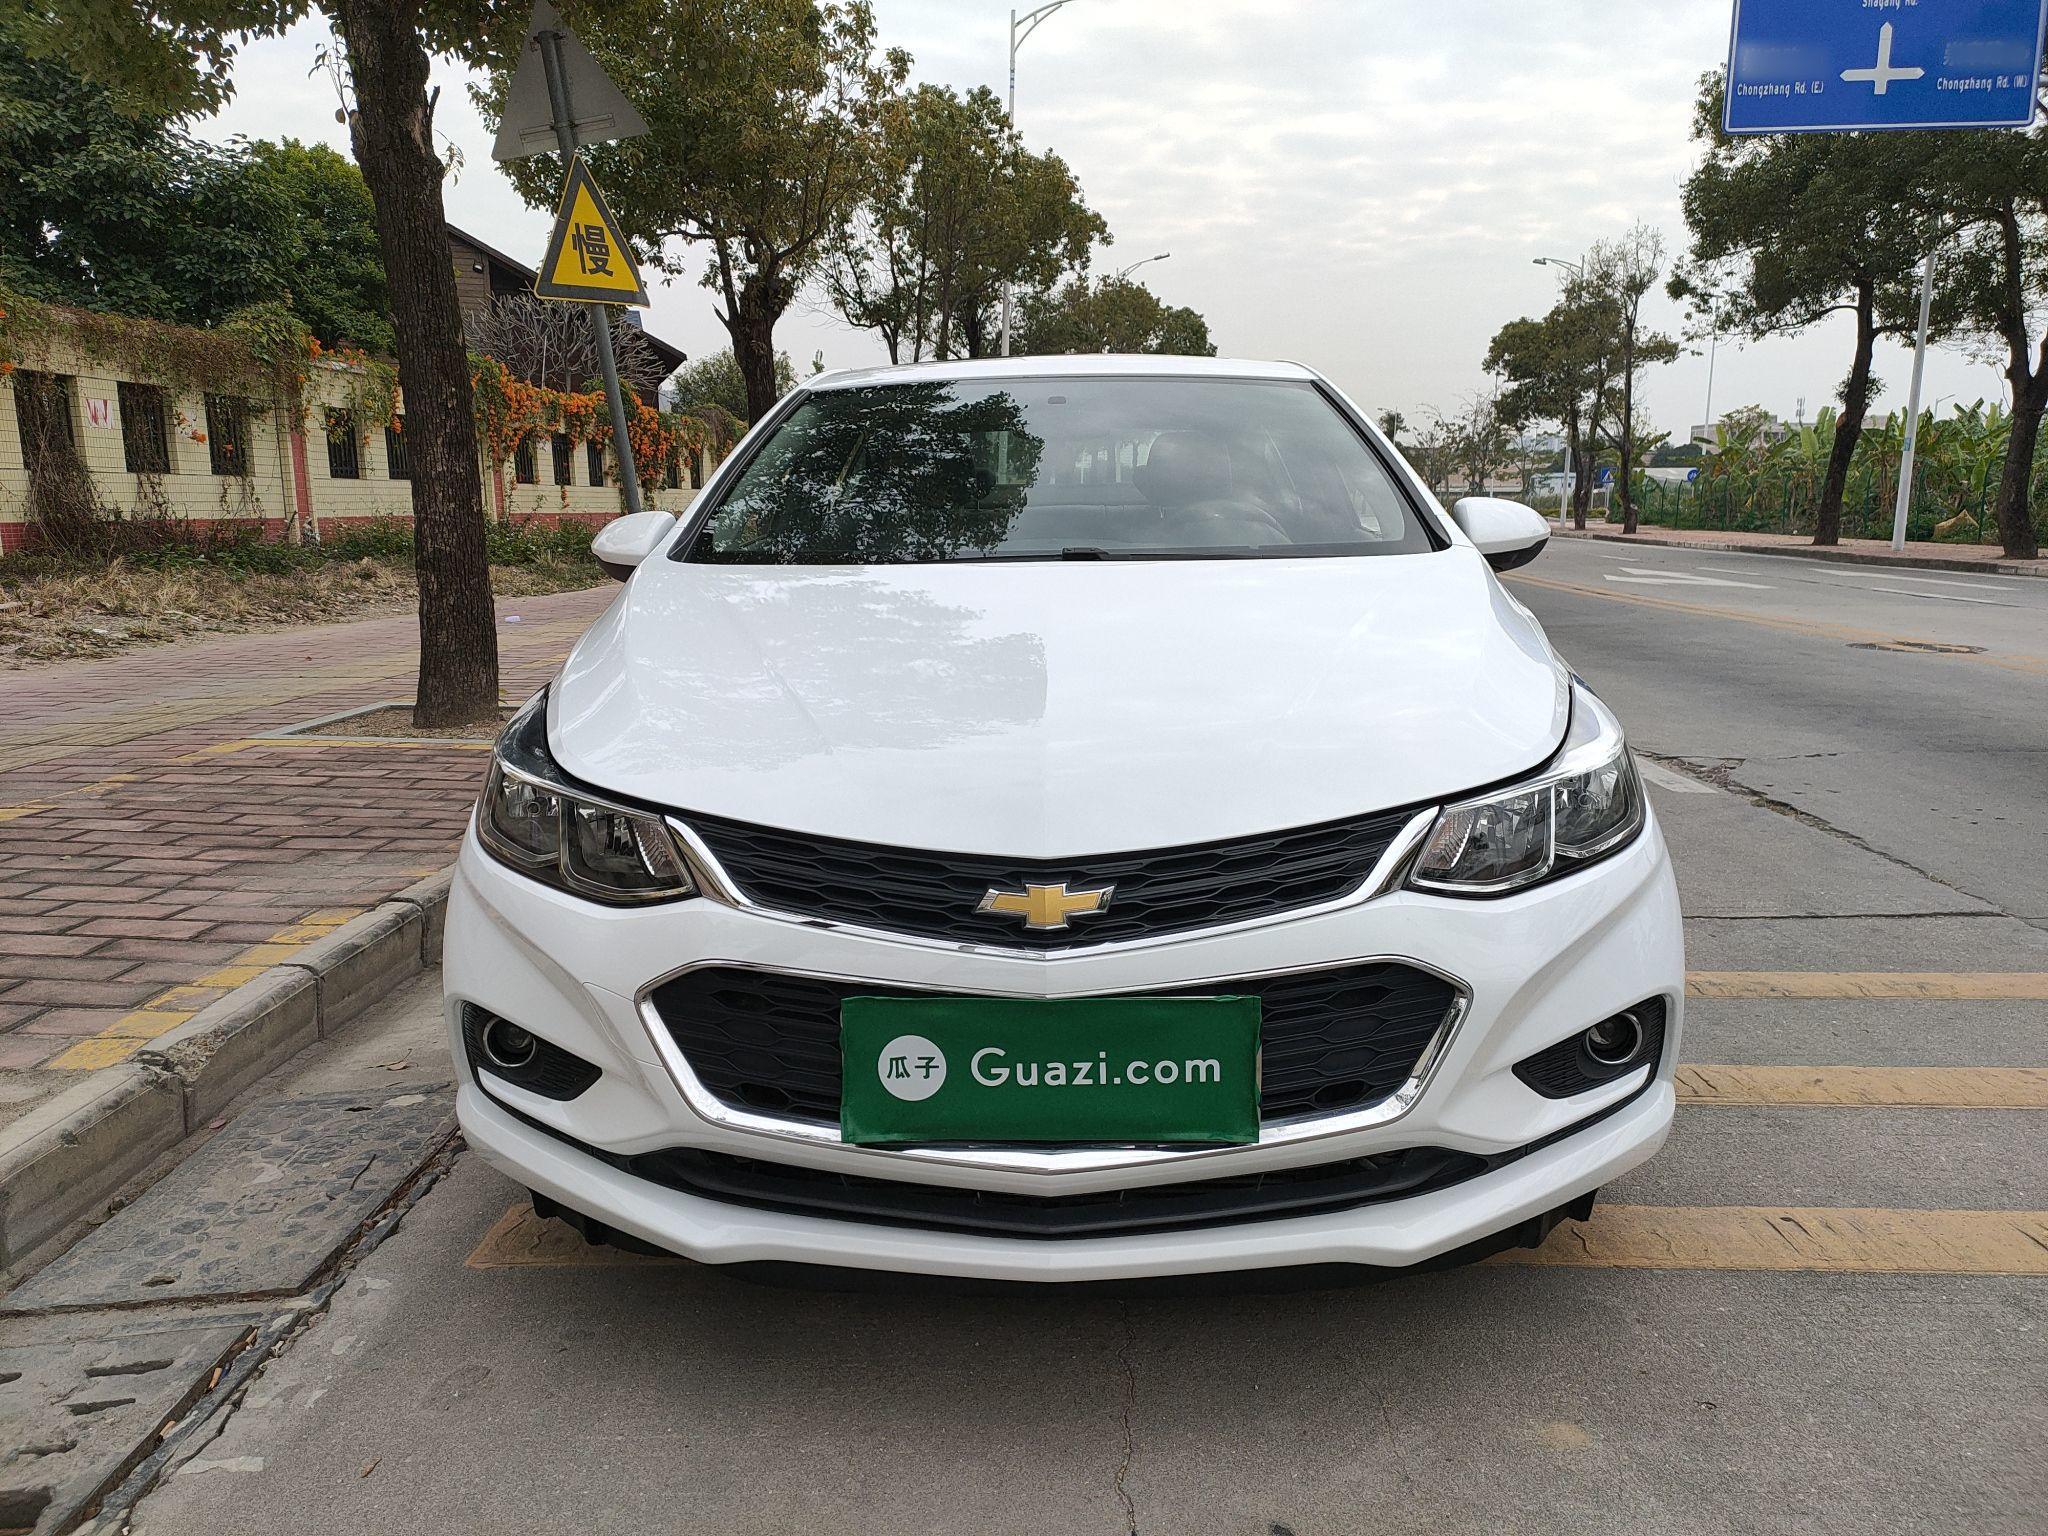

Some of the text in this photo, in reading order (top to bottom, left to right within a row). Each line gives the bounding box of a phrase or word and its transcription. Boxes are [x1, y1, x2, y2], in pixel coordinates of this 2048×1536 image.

[1737, 80, 1824, 99] Chongzhang Rd. (E.)
[1937, 77, 1992, 94] Chongzhang
[1996, 75, 2010, 89] Rd.
[572, 223, 613, 277] 慢
[887, 1056, 939, 1079] 瓜子
[971, 1047, 1221, 1087] Guazi.com
